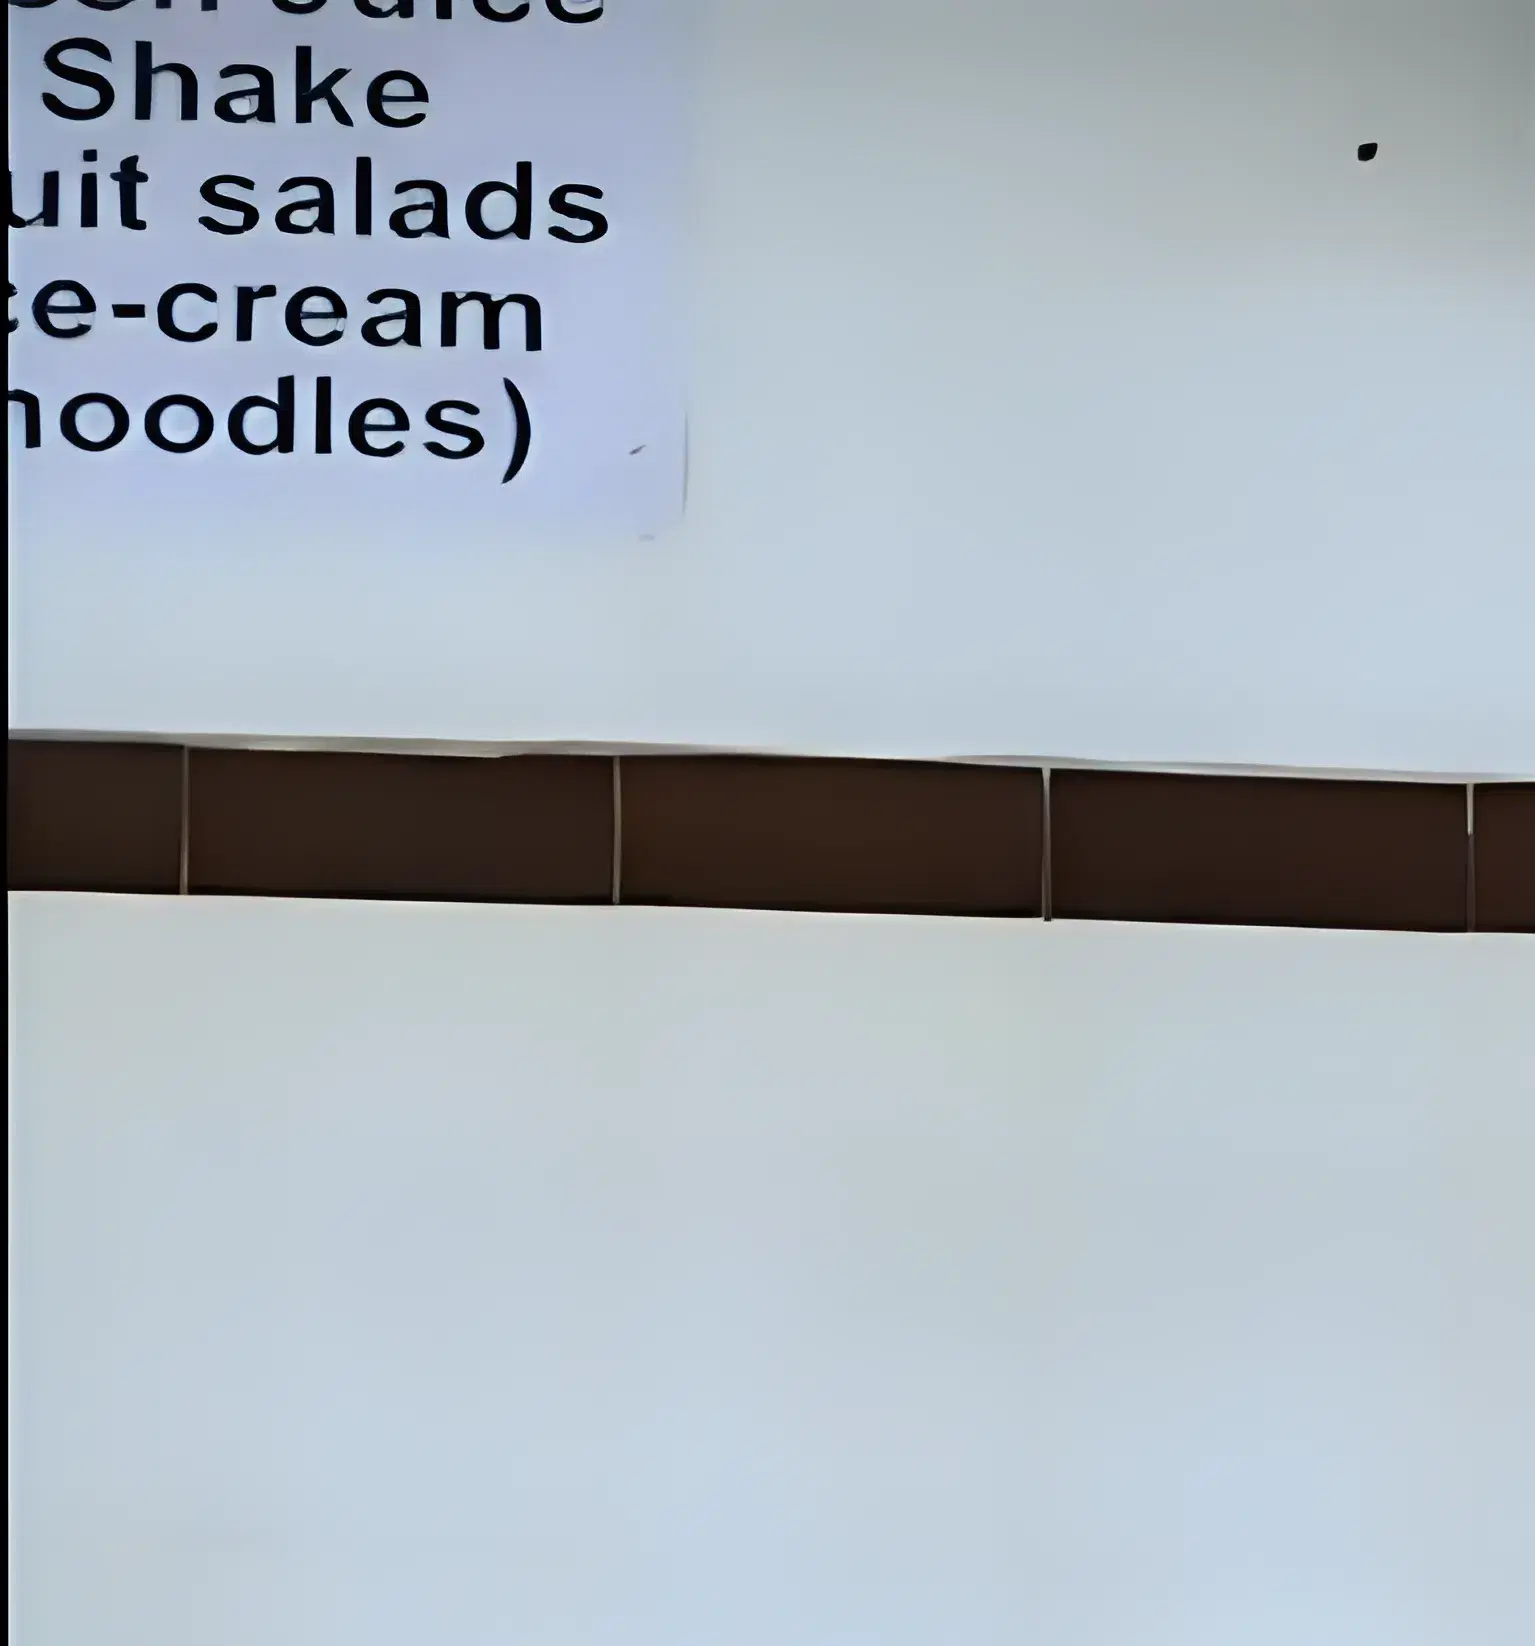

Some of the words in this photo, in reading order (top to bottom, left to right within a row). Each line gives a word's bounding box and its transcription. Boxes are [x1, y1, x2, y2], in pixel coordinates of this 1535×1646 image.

[41, 37, 430, 129] Shake
[198, 156, 609, 243] salads
[9, 279, 542, 352] e-cream
